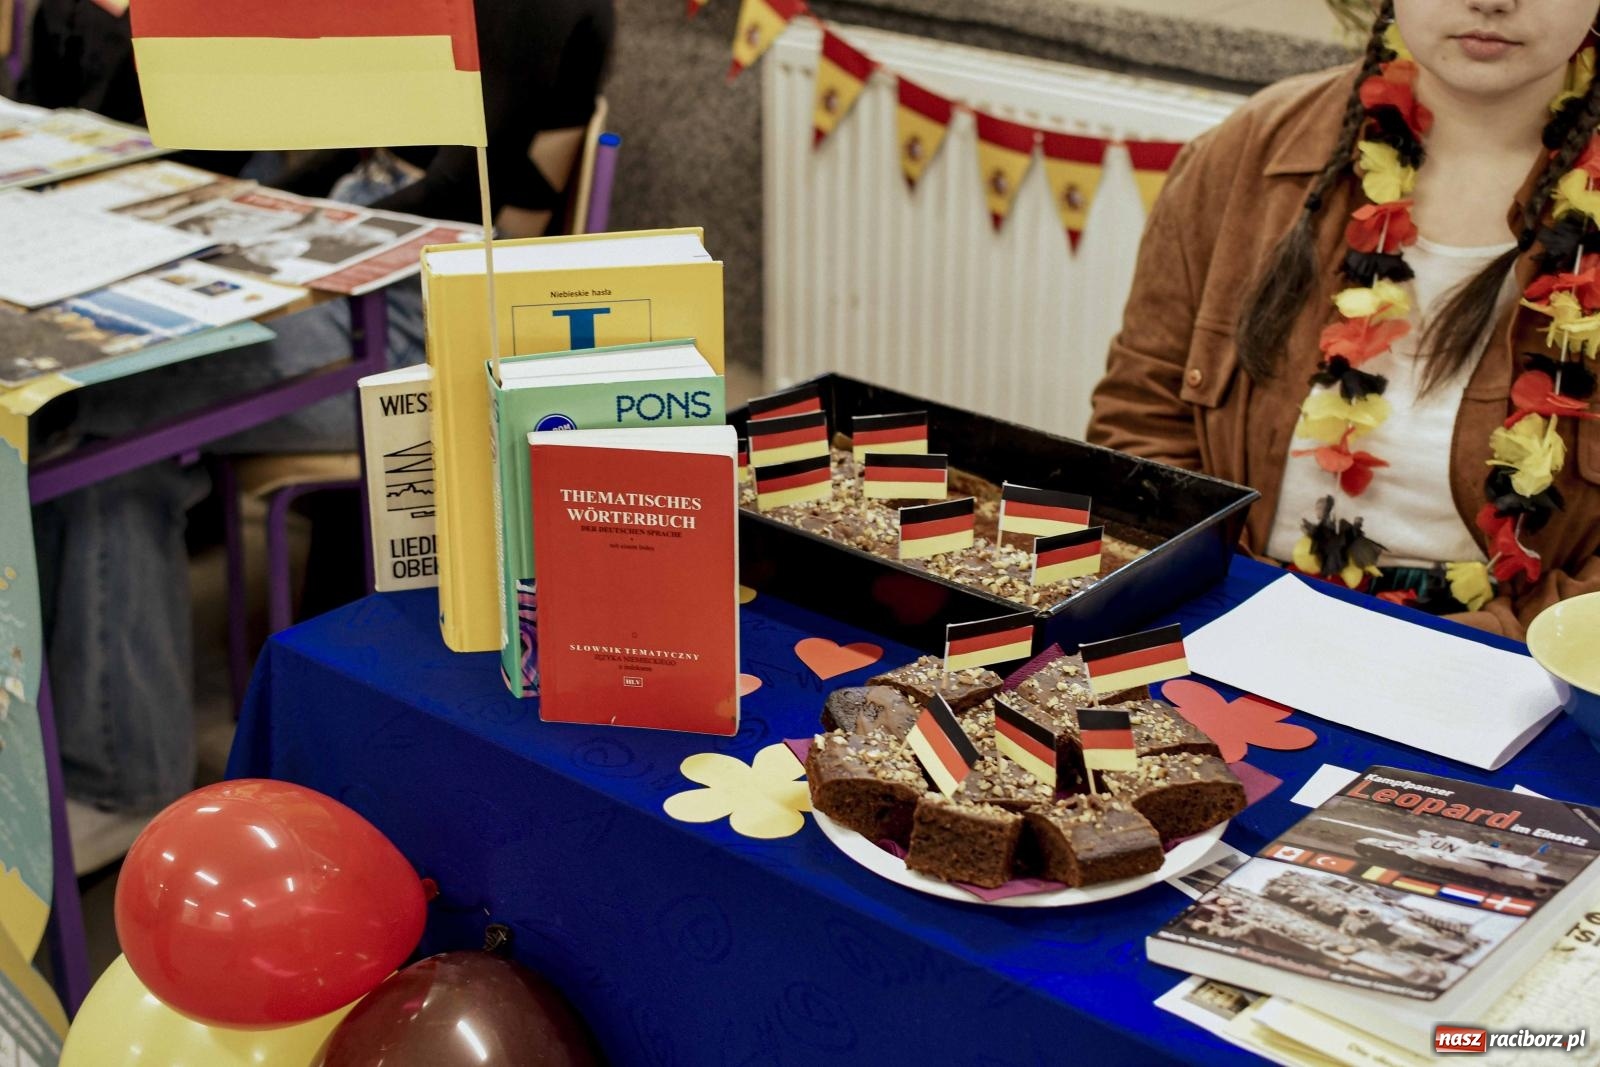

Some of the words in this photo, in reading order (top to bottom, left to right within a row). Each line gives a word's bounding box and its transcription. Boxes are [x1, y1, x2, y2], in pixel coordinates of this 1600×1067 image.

[550, 290, 590, 299] Niebieskie
[379, 392, 432, 416] WIES
[616, 390, 712, 422] PONS
[560, 488, 702, 511] THEMATISCHES
[567, 507, 697, 530] WÖRTERBUCH
[598, 526, 645, 535] DEUTSCHEN
[647, 529, 682, 538] SPRACHE
[391, 534, 437, 558] LIED
[393, 556, 438, 579] OBE
[569, 644, 622, 654] SŁOWNIK
[624, 647, 701, 661] TEMATYCZNY
[1364, 773, 1456, 798] Kampfpanzer
[1346, 780, 1522, 831] Leopard
[1509, 823, 1532, 835] im
[1531, 828, 1589, 847] Einsatz
[1431, 839, 1460, 854] UN
